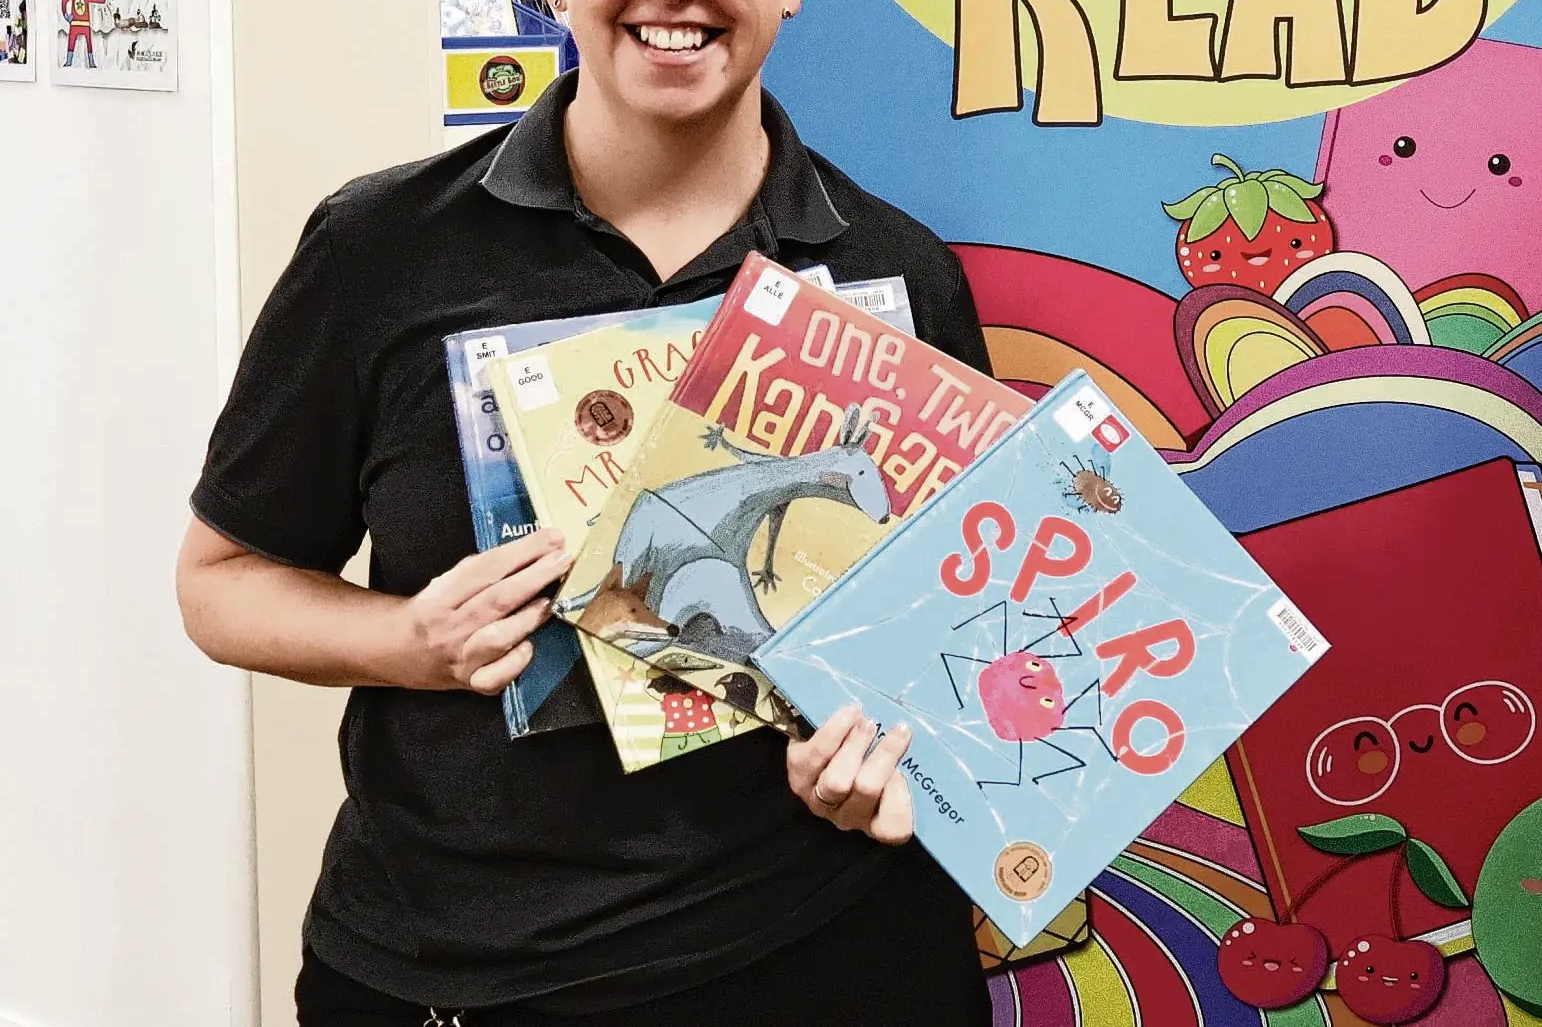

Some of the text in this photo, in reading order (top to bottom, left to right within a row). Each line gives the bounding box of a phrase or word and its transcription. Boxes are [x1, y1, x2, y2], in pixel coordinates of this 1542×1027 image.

[775, 280, 781, 288] E
[763, 285, 784, 300] ALLE
[481, 342, 488, 350] E
[476, 350, 497, 360] SMIT
[524, 366, 531, 374] E
[518, 372, 544, 386] GOOD
[1075, 400, 1094, 421] MCGR
[1087, 401, 1095, 409] E
[565, 450, 626, 507] MR
[940, 500, 1196, 776] SPIRO
[901, 756, 965, 825] McGregor
